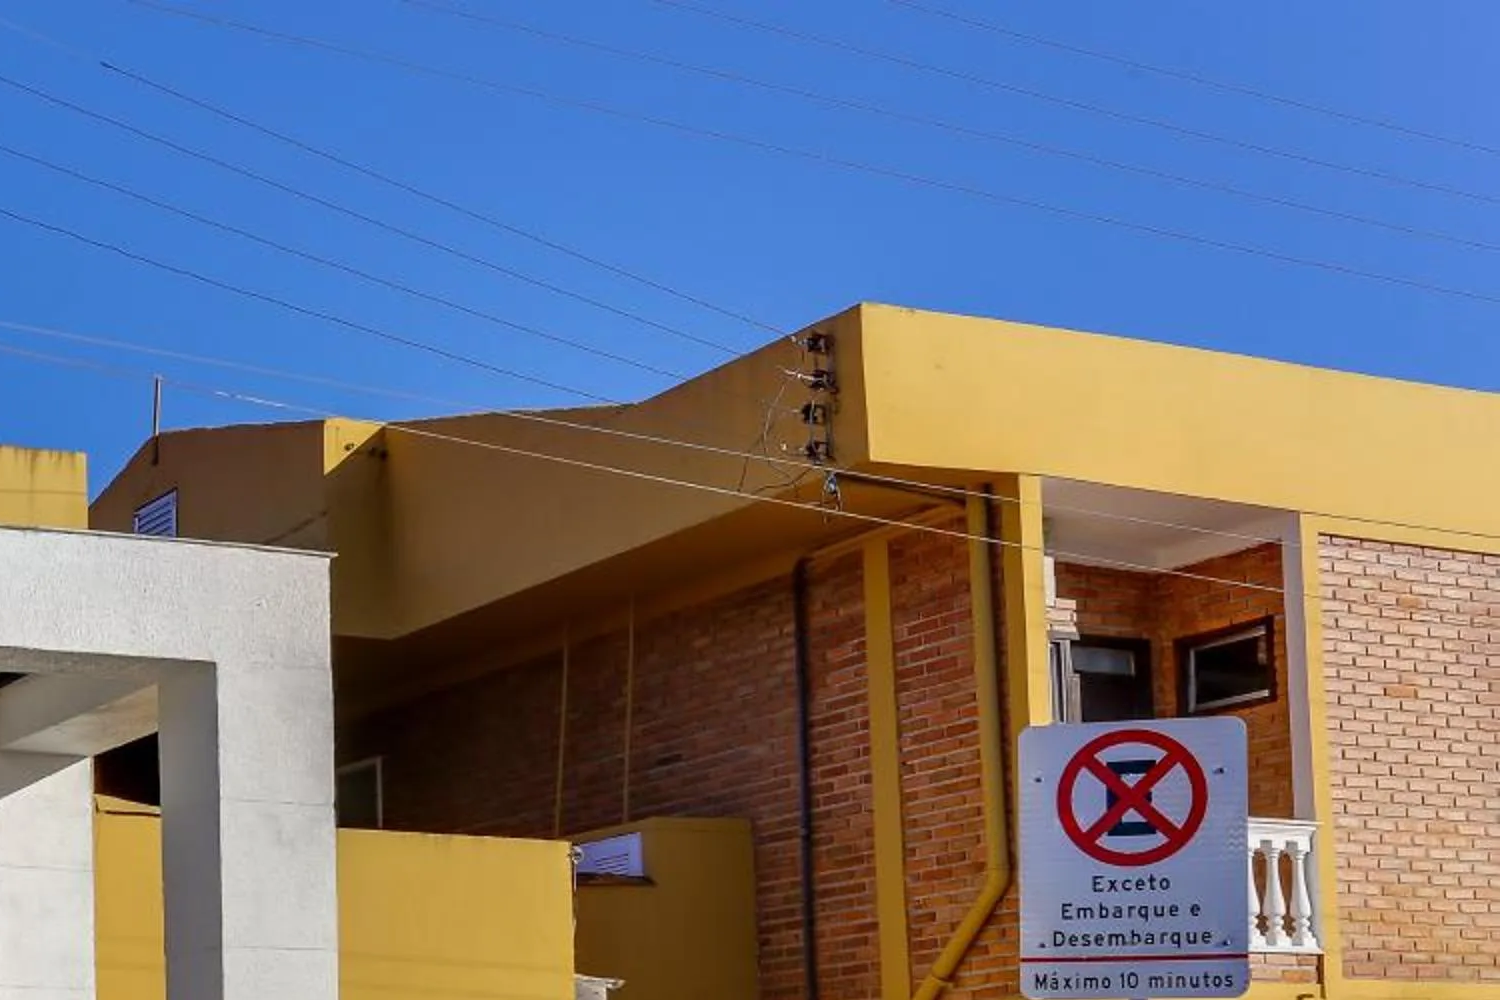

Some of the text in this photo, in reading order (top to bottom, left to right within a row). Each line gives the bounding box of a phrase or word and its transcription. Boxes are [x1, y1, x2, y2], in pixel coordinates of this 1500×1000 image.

[1092, 873, 1171, 893] Exceto
[1061, 902, 1202, 921] Embarque e
[1053, 930, 1213, 949] Desembarque
[1035, 971, 1234, 991] Máximo 10 minutos
